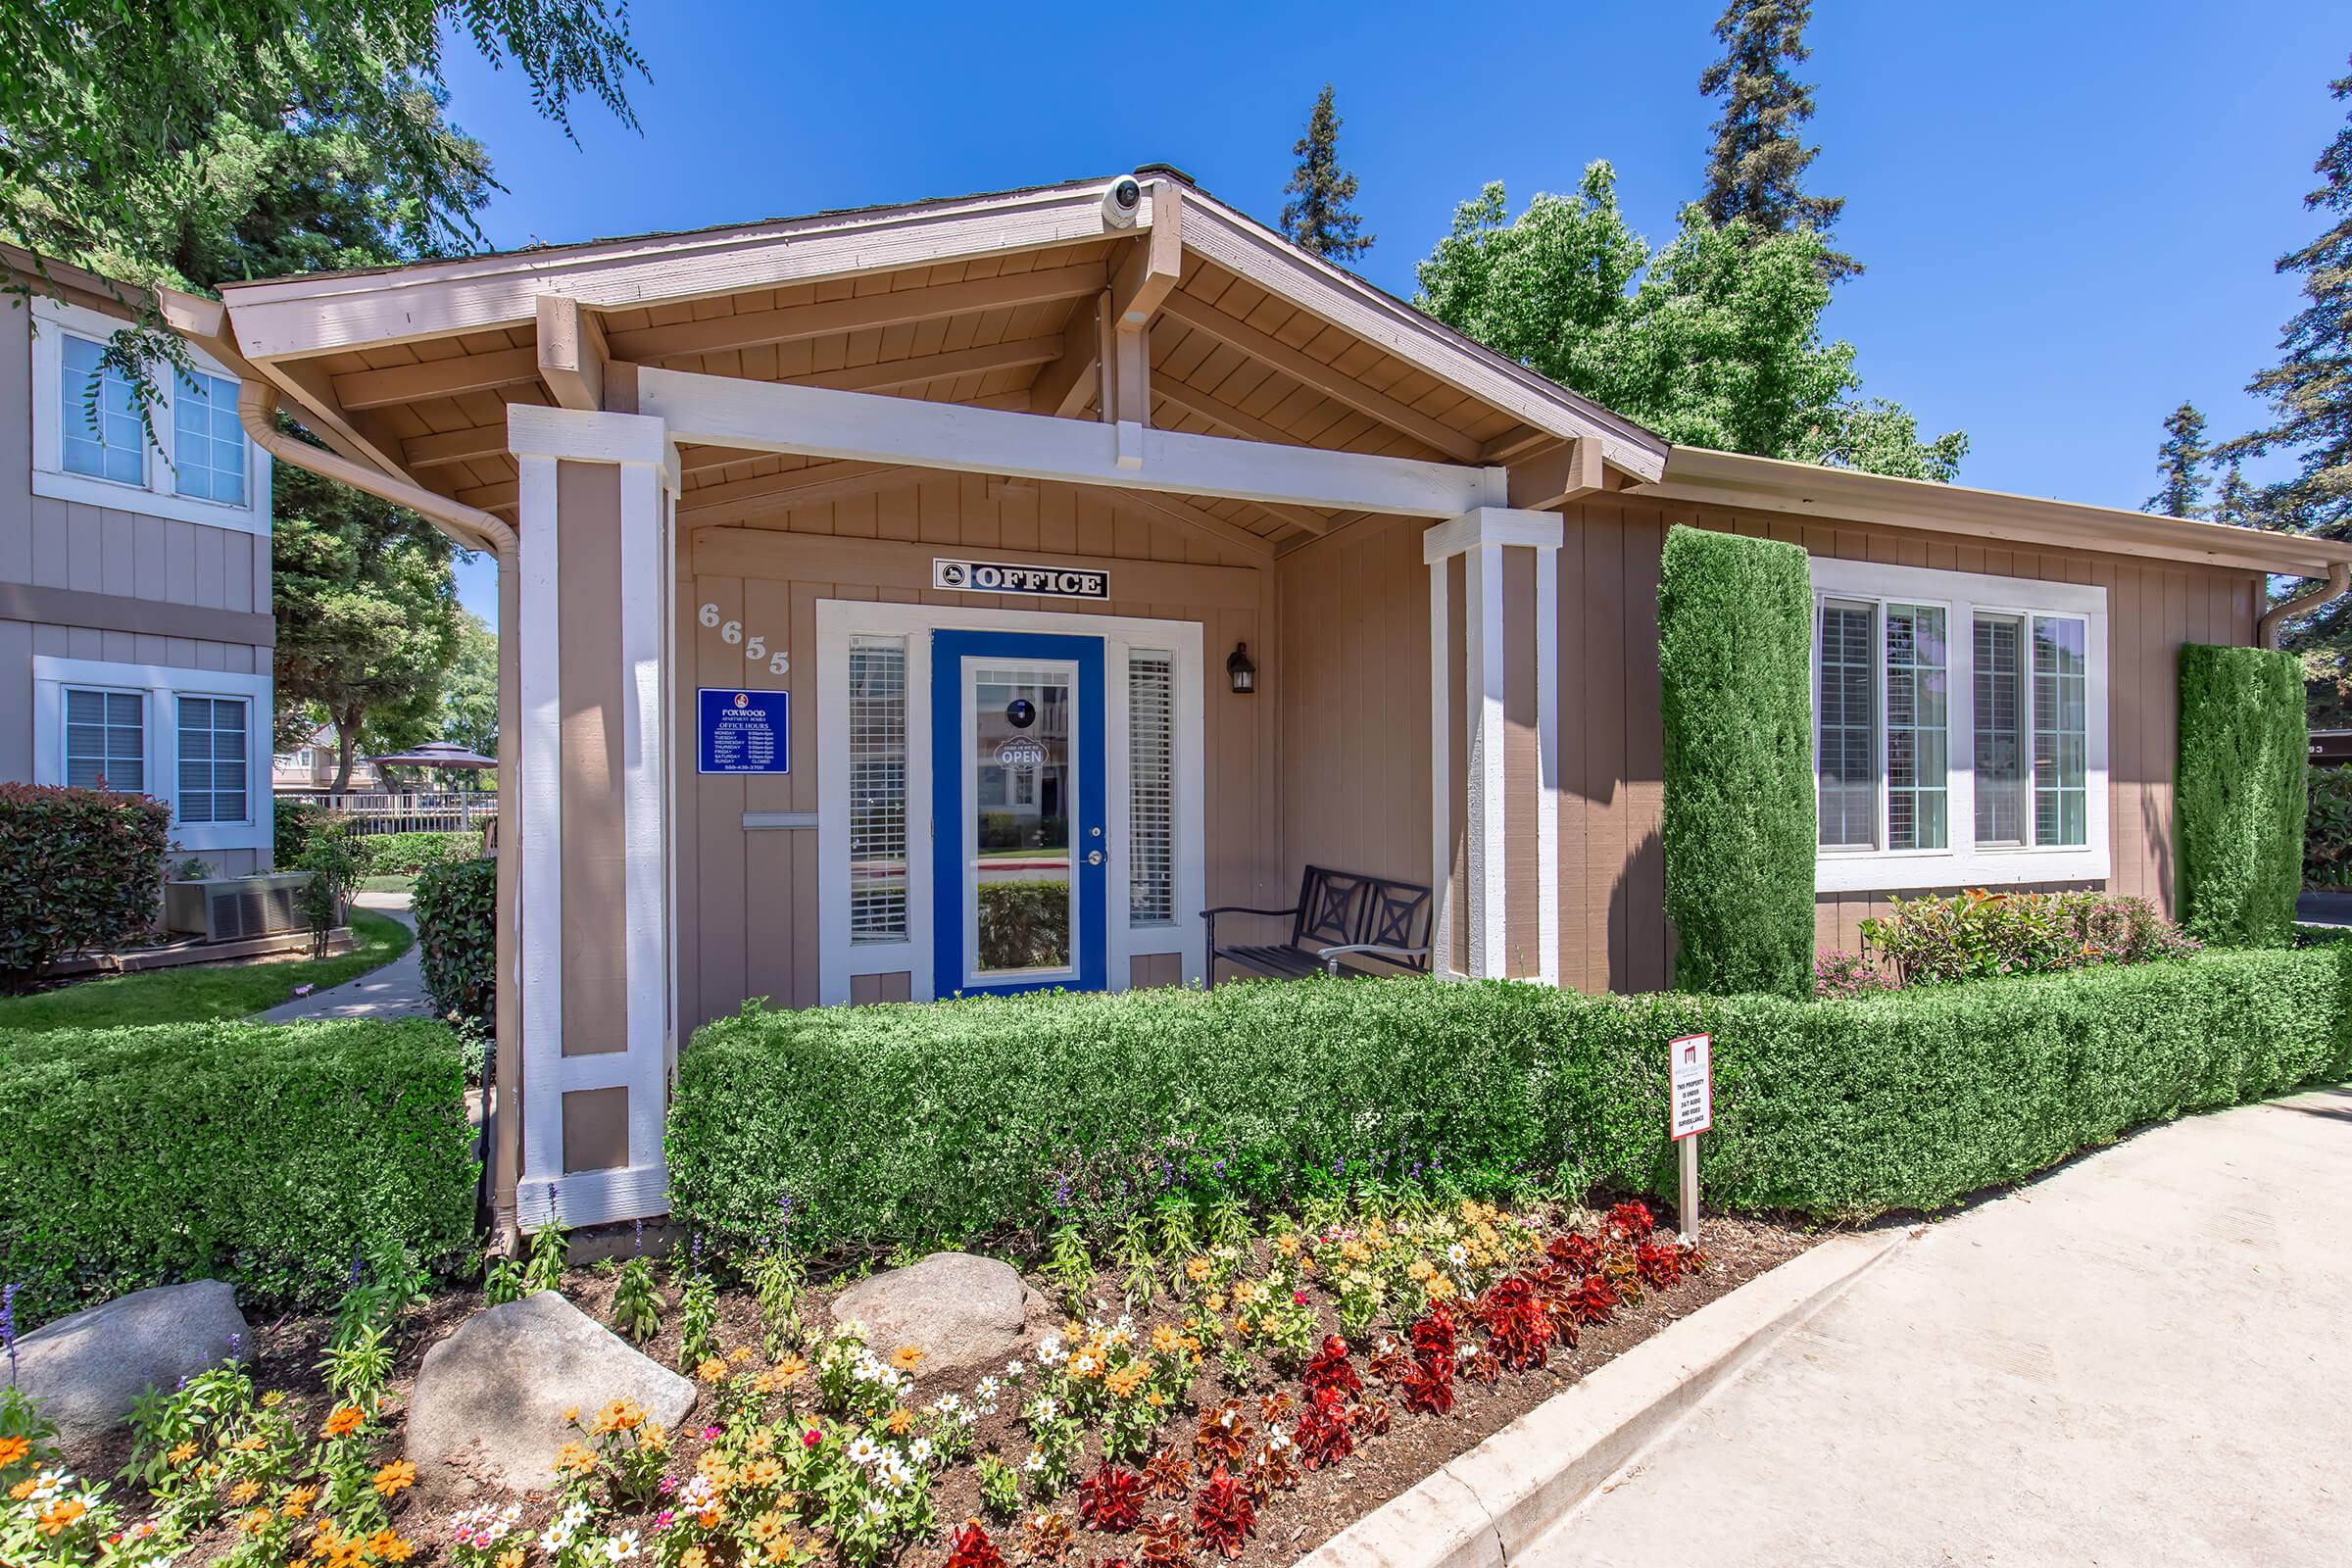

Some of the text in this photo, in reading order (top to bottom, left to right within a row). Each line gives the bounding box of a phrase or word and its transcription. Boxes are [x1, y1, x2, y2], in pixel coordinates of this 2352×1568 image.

[975, 567, 1102, 595] OFFICE
[699, 603, 790, 675] 6655
[1003, 751, 1042, 763] OPEN
[1686, 1079, 1704, 1088] PROPERTY
[1687, 1089, 1699, 1098] UNDER
[1678, 1115, 1704, 1127] SURVEILLANCE
